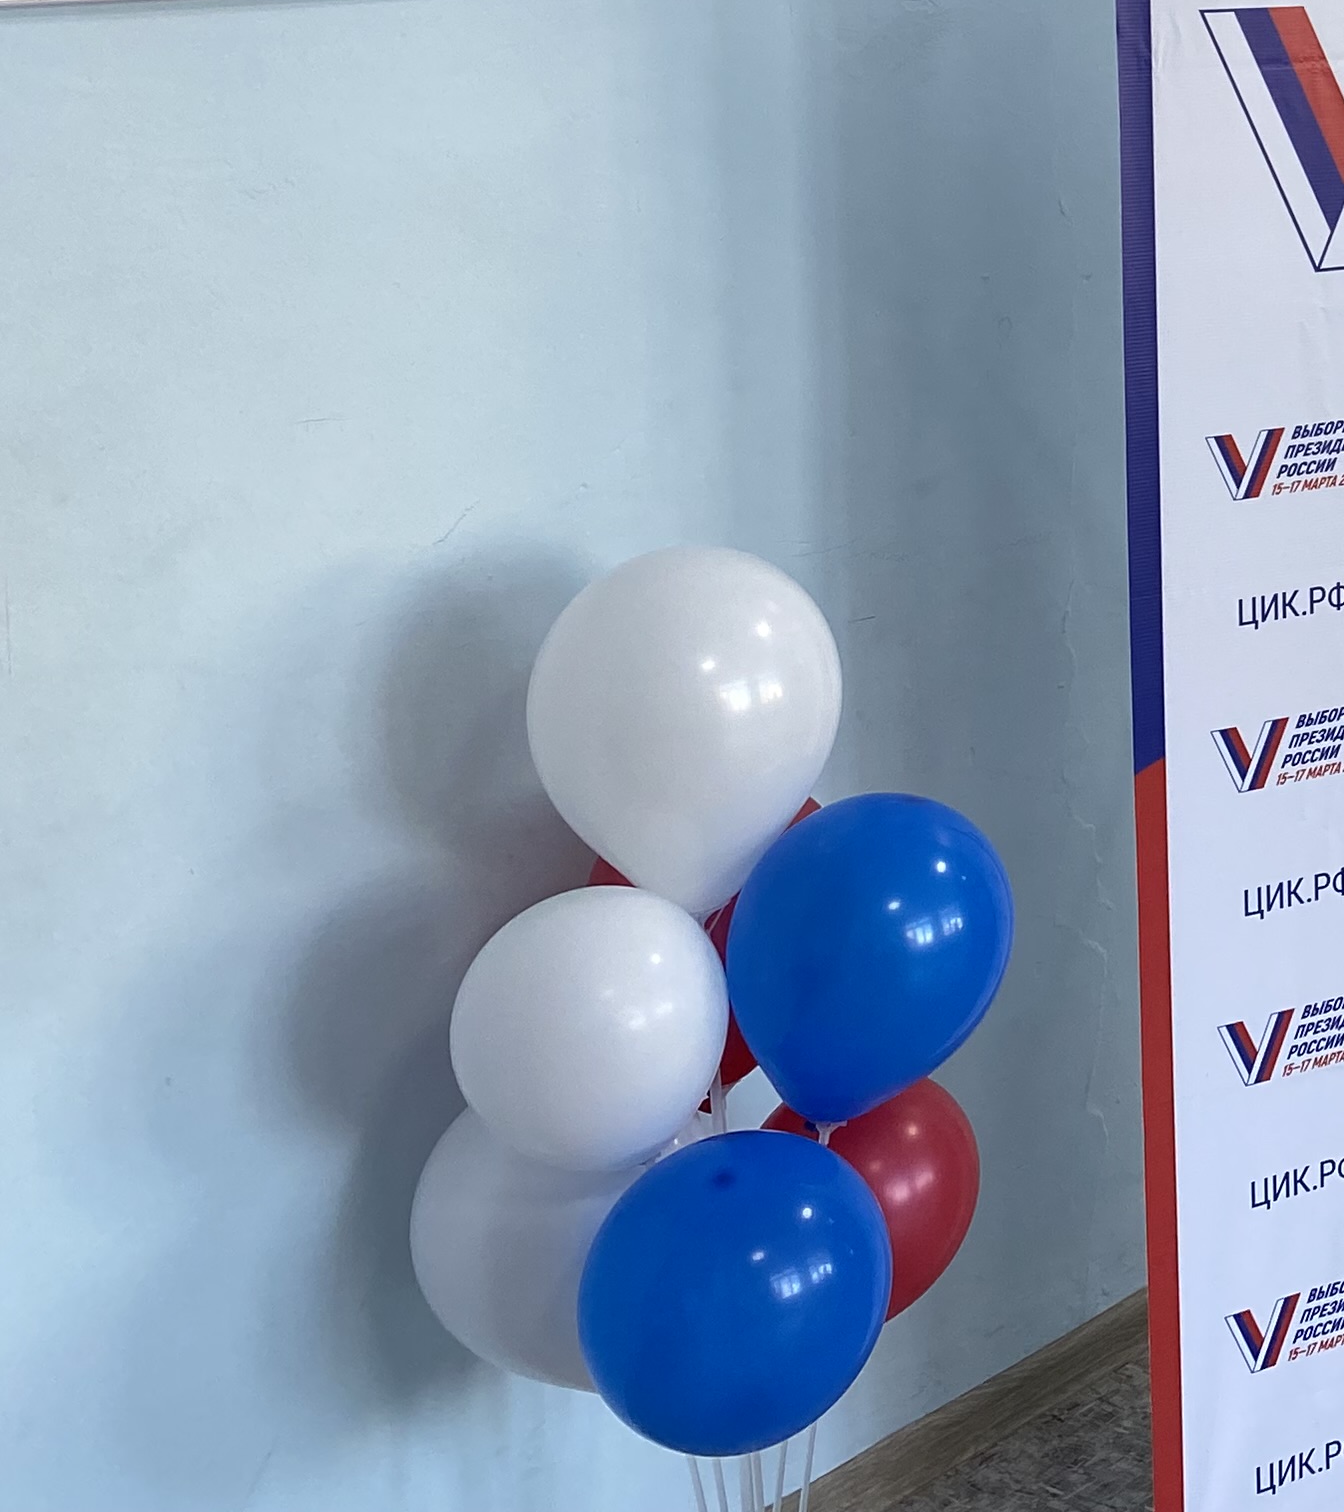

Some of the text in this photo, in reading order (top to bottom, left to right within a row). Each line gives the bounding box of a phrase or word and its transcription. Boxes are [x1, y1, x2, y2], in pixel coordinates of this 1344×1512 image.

[1277, 458, 1337, 479] РОССИИ
[1301, 474, 1337, 492] МАРТА
[1281, 744, 1342, 769] РОССИИ
